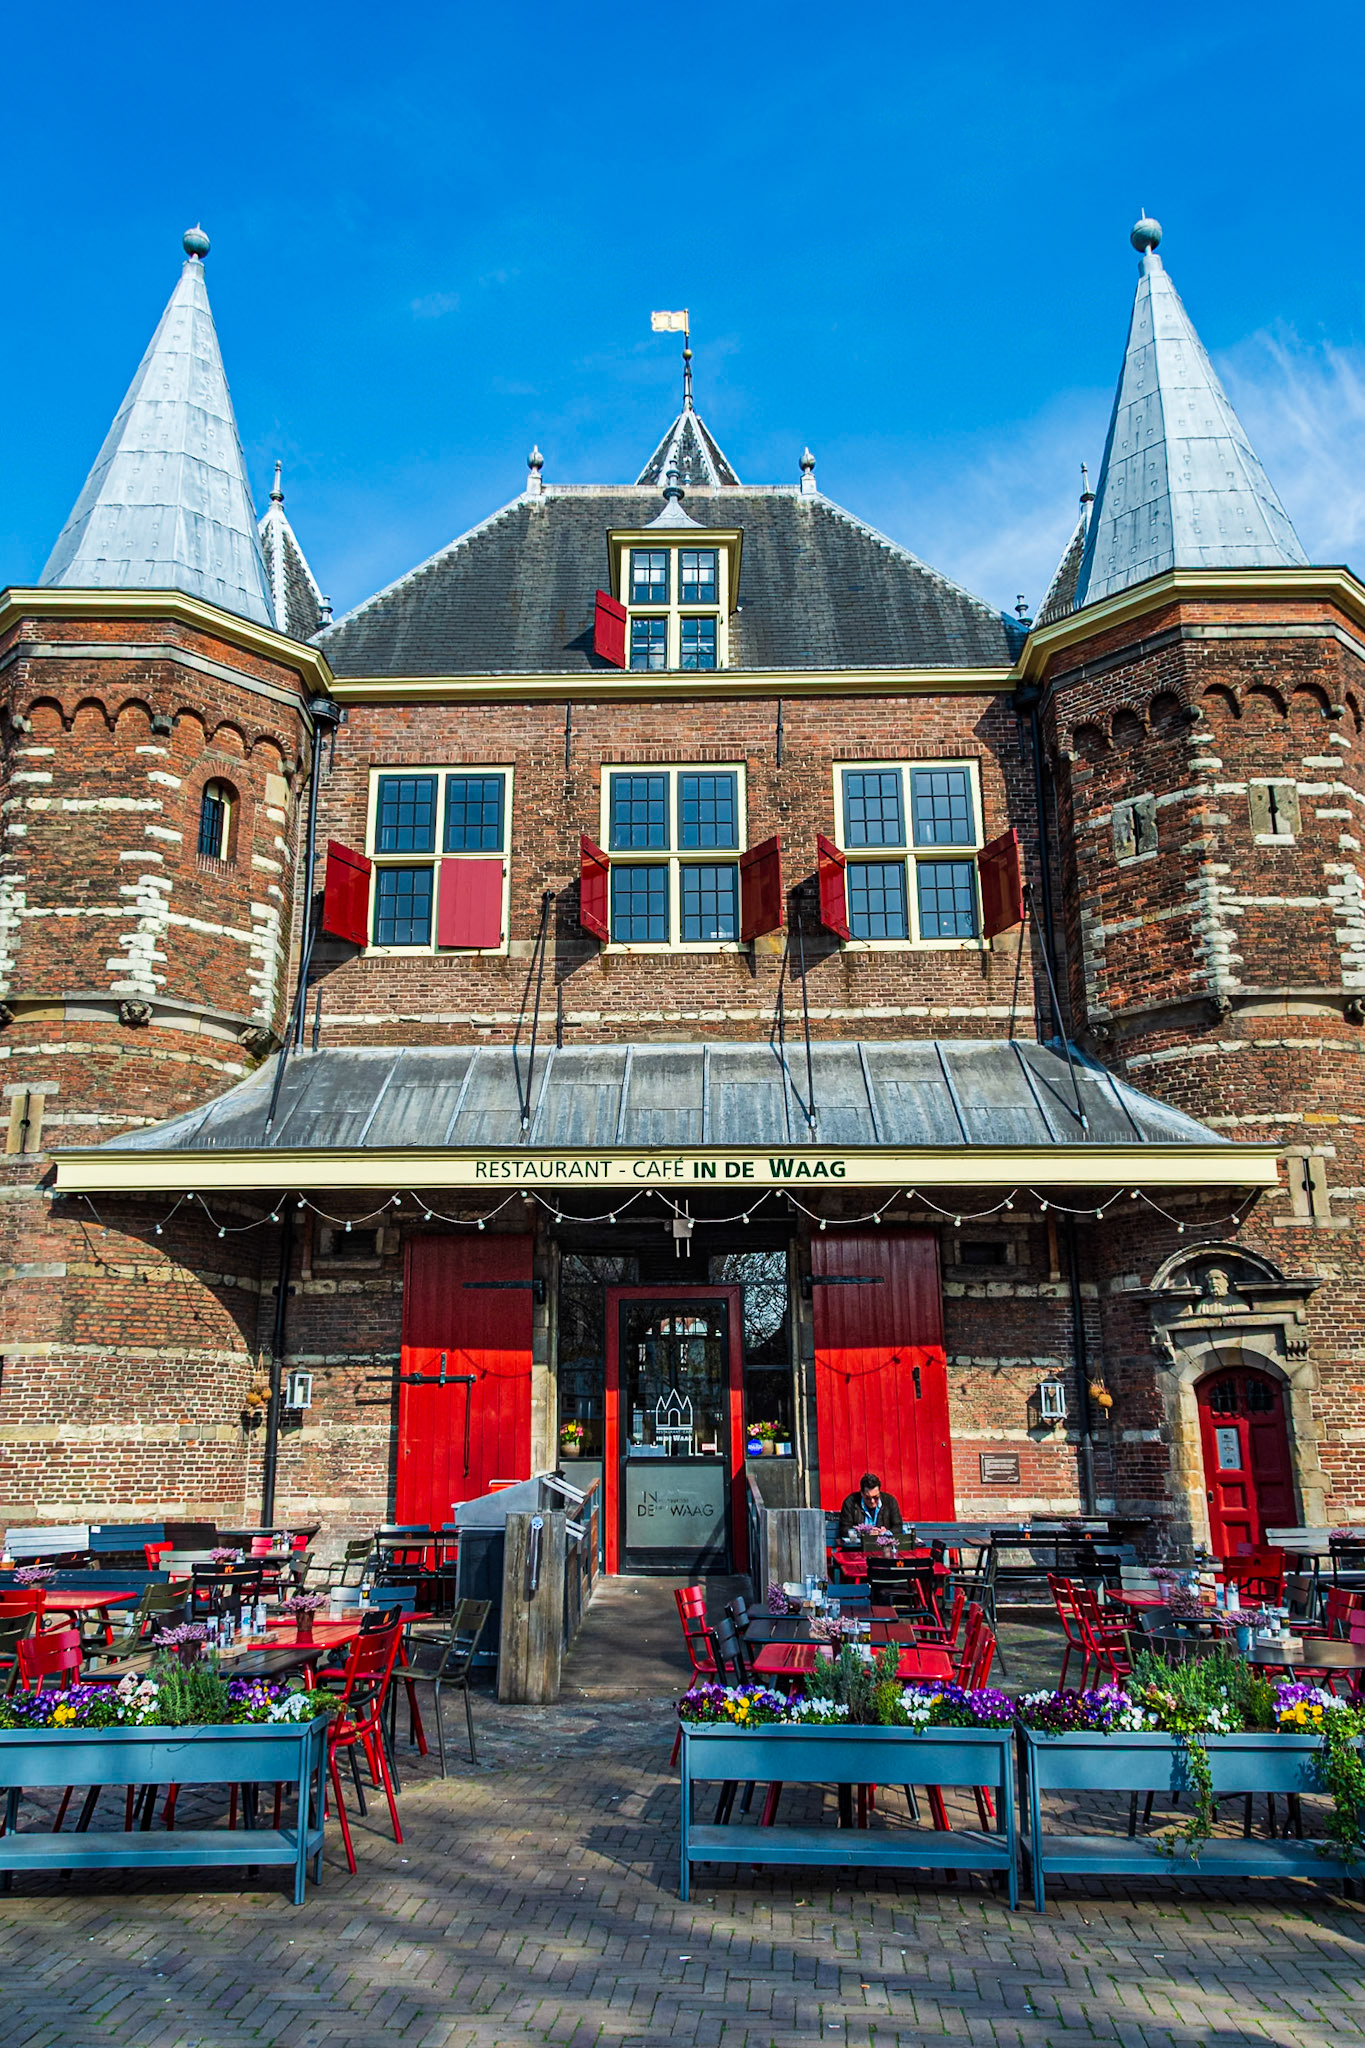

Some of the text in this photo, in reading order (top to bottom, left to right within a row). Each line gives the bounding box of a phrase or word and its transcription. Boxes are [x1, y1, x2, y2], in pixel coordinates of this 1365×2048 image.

[475, 1161, 613, 1178] RESTAURANT
[632, 1156, 685, 1178] CAFÉ
[693, 1161, 717, 1178] IN
[725, 1161, 755, 1178] DE
[769, 1158, 846, 1178] WAAG
[643, 1491, 658, 1503] IN
[637, 1504, 714, 1517] DE WAAG
